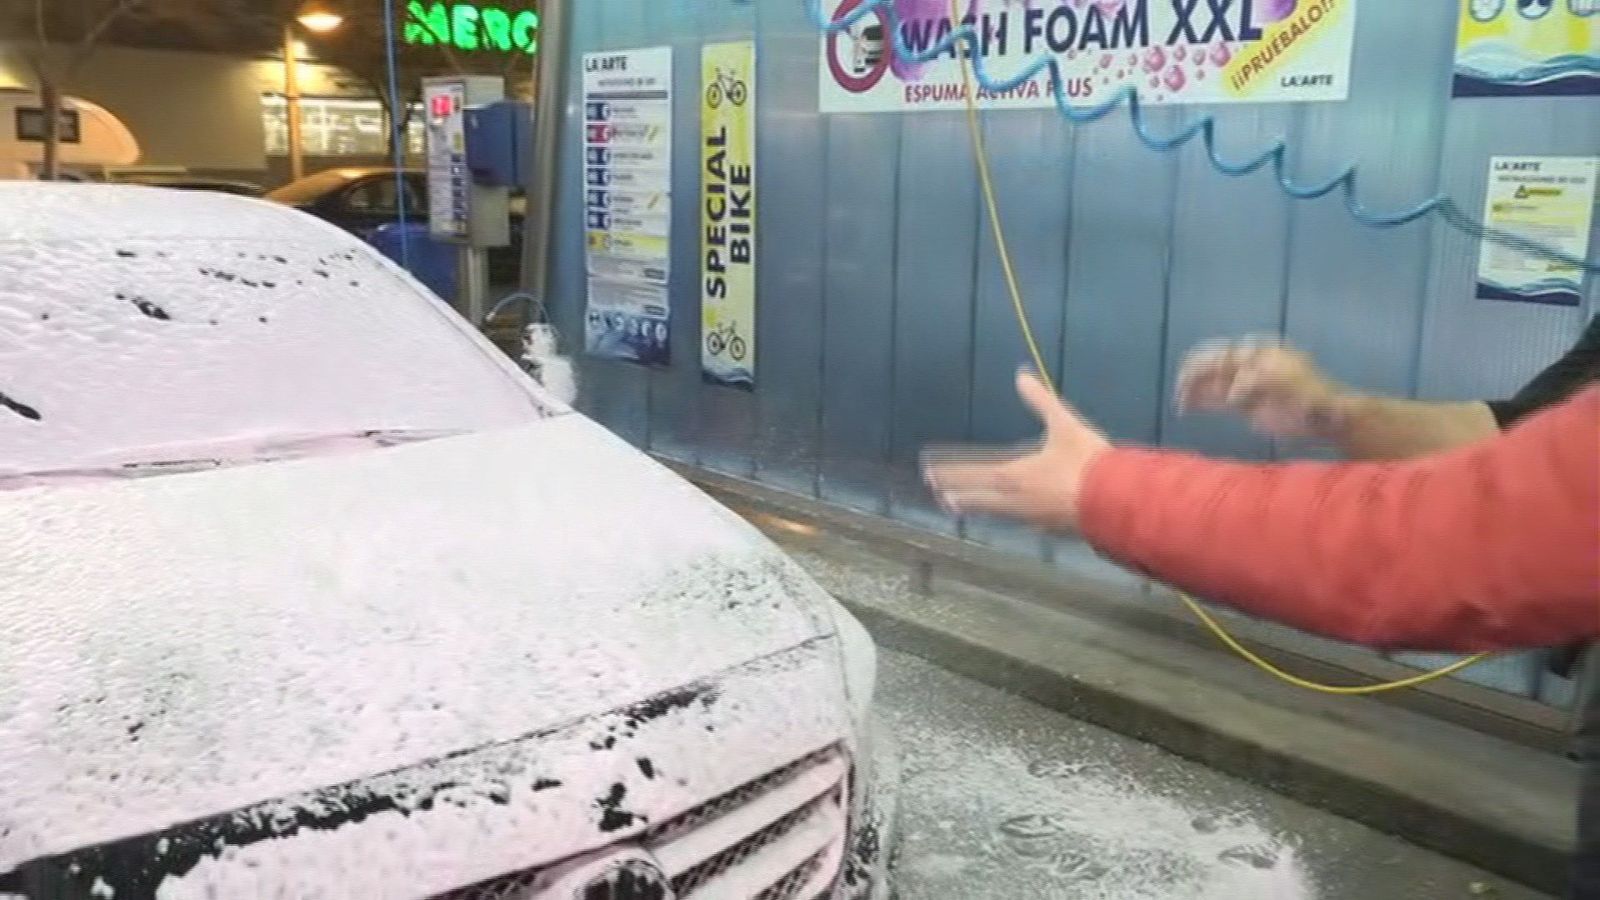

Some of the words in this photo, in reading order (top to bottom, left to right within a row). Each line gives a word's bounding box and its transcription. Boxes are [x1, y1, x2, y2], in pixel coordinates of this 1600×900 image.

[1024, 0, 1149, 53] FOAM
[1166, 0, 1262, 45] XXL
[905, 83, 970, 103] ESPUMA
[1046, 77, 1092, 98] PUS
[706, 126, 727, 299] SPECIAL
[730, 164, 751, 265] BIKE
